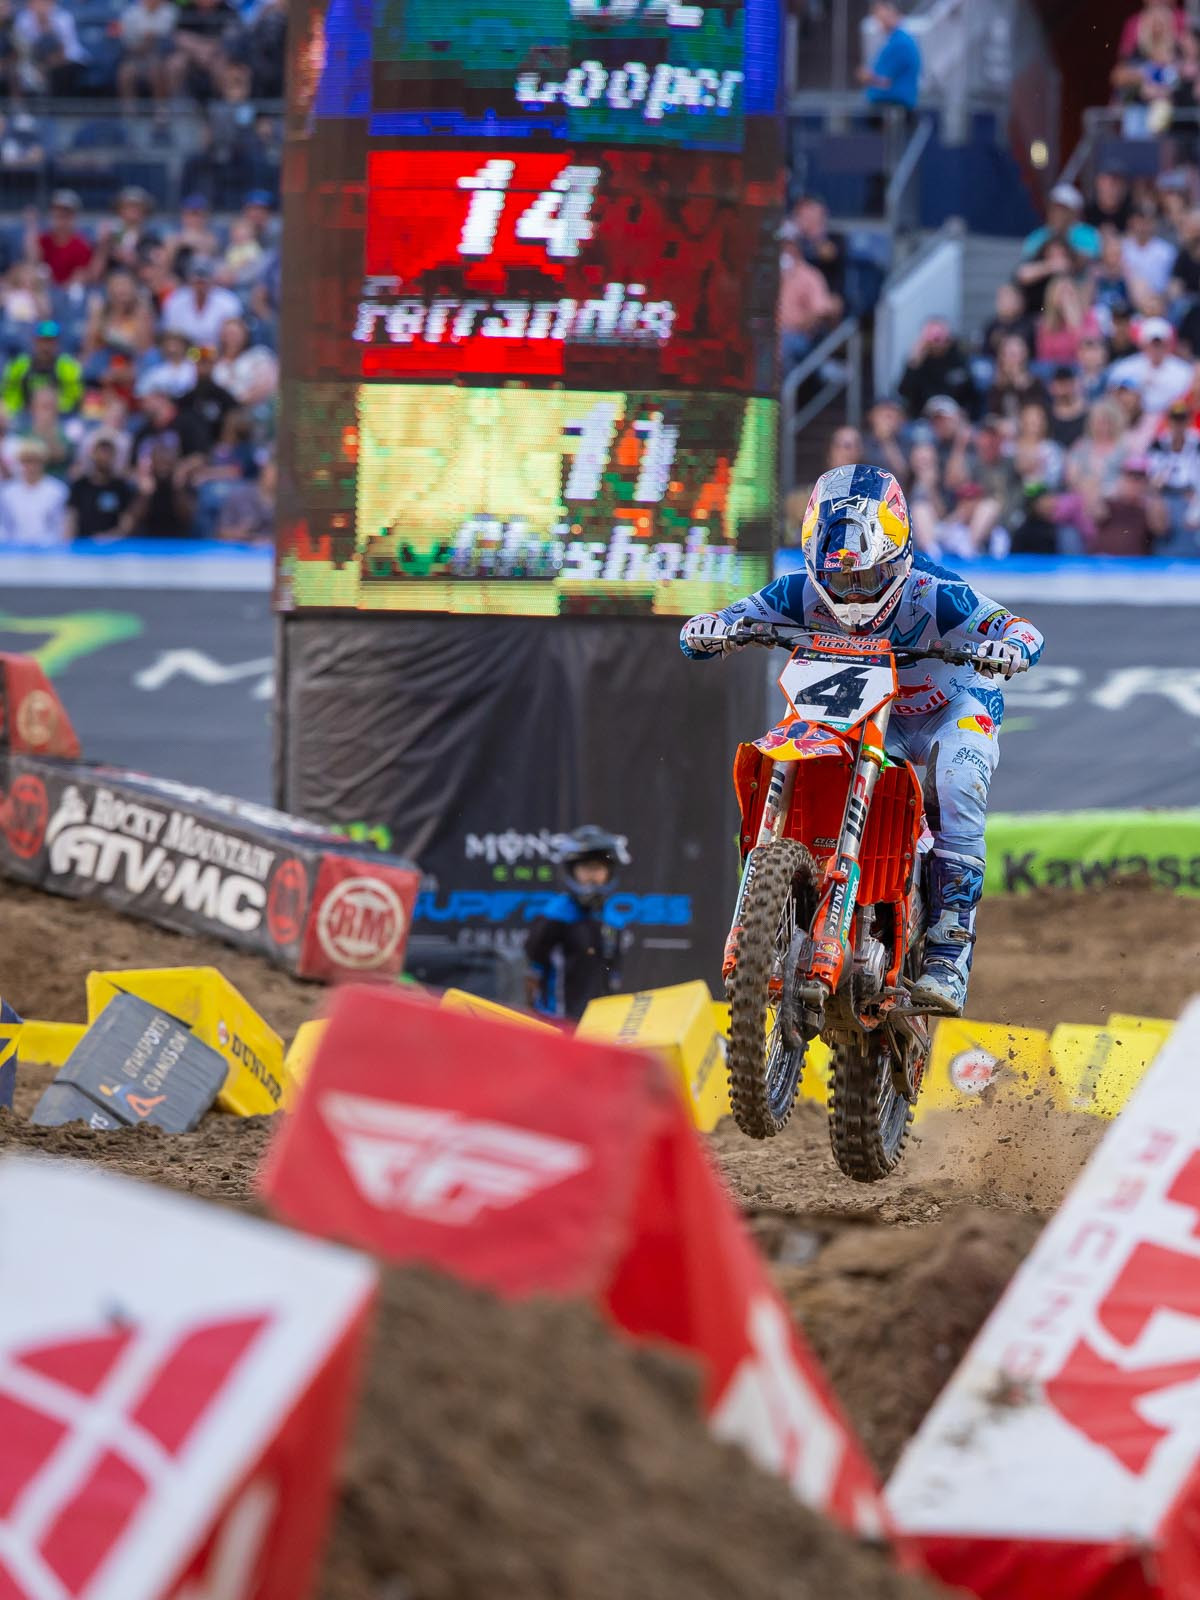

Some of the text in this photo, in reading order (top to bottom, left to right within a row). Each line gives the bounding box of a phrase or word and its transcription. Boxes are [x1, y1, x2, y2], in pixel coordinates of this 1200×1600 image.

[457, 159, 601, 261] 14
[818, 640, 880, 651] RENTHAL
[794, 667, 873, 718] 4
[893, 689, 947, 715] Bull
[91, 786, 166, 841] ROCKY
[830, 862, 850, 926] DUNLP
